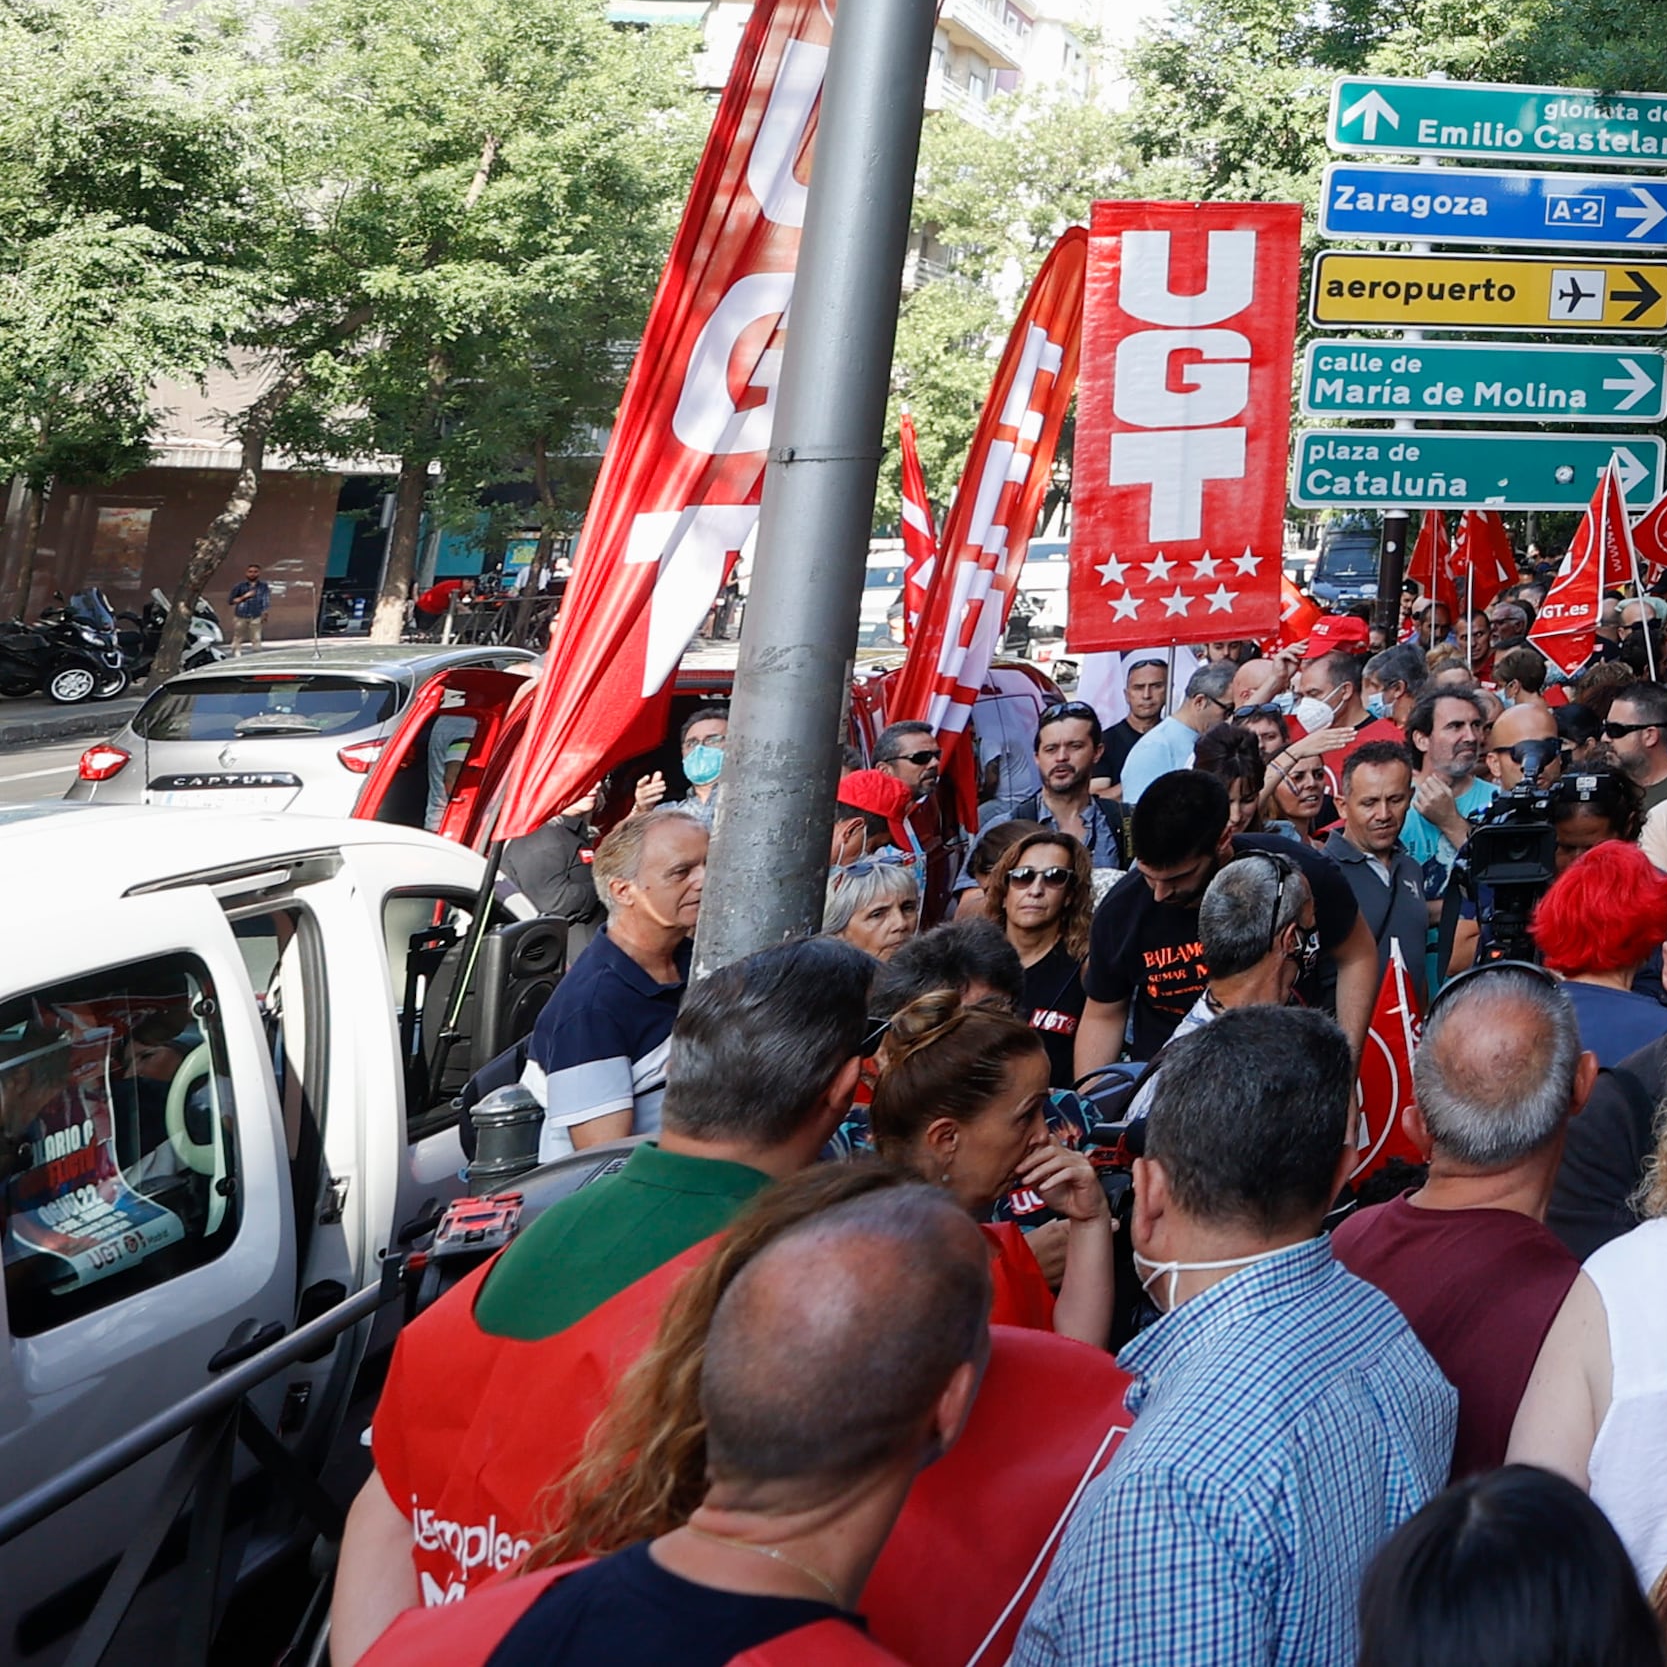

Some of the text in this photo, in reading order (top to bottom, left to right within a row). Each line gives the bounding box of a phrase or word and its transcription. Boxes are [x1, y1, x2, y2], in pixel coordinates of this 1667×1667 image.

[1544, 99, 1640, 123] glorieta
[1417, 119, 1523, 149] Emilio
[1334, 185, 1599, 223] Zaragoza A-2
[1326, 276, 1516, 306] aeropuerto
[1318, 353, 1422, 375] calle de
[1108, 230, 1257, 543] UGT
[1314, 378, 1588, 410] María de Molina
[1308, 441, 1420, 465] plaza de
[1306, 470, 1468, 498] Cataluña
[173, 775, 273, 786] CAPTUR
